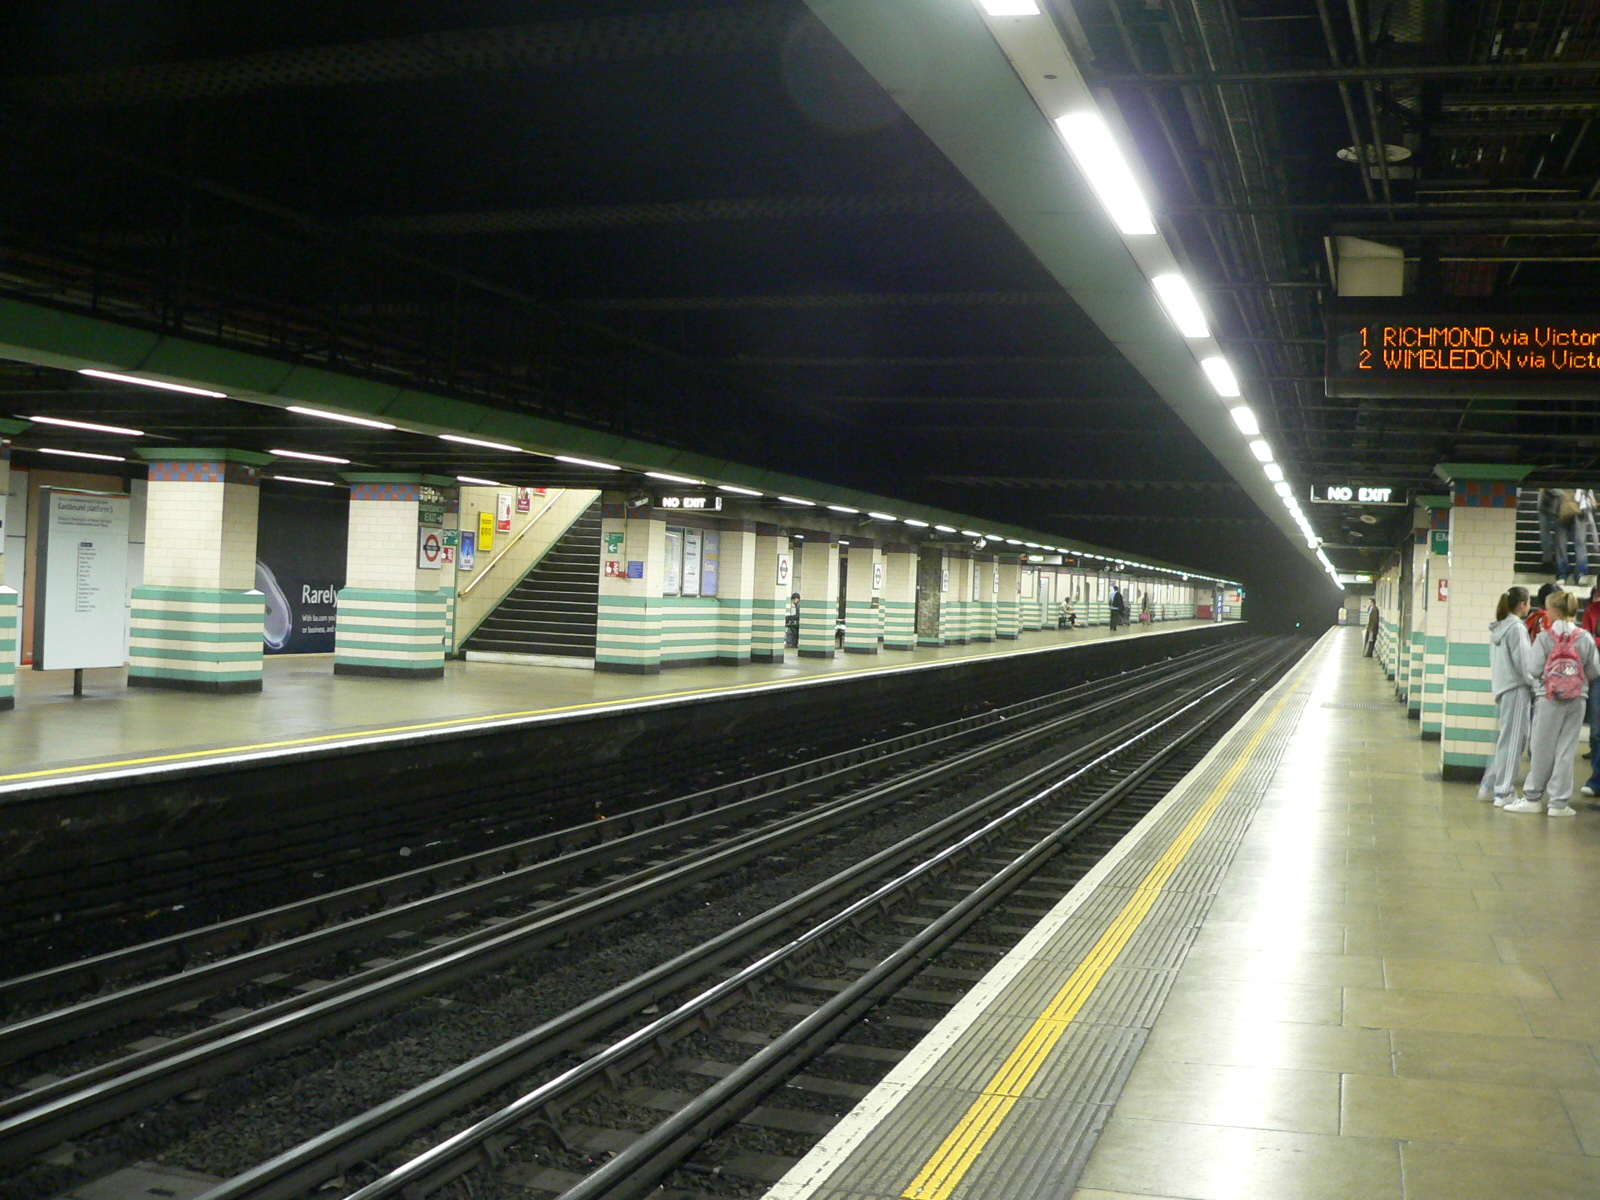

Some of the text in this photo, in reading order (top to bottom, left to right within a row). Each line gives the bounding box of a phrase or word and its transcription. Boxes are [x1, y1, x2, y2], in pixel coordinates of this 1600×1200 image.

[1360, 327, 1367, 346] 1
[1383, 327, 1495, 348] RICHMOND
[1500, 329, 1528, 346] via
[1358, 349, 1373, 369] 2
[1383, 349, 1511, 370] WIMBLEDON
[1517, 351, 1546, 368] via
[662, 498, 707, 508] NO EXIT
[1327, 486, 1392, 502] NO EXIT
[302, 584, 338, 607] Rarely
